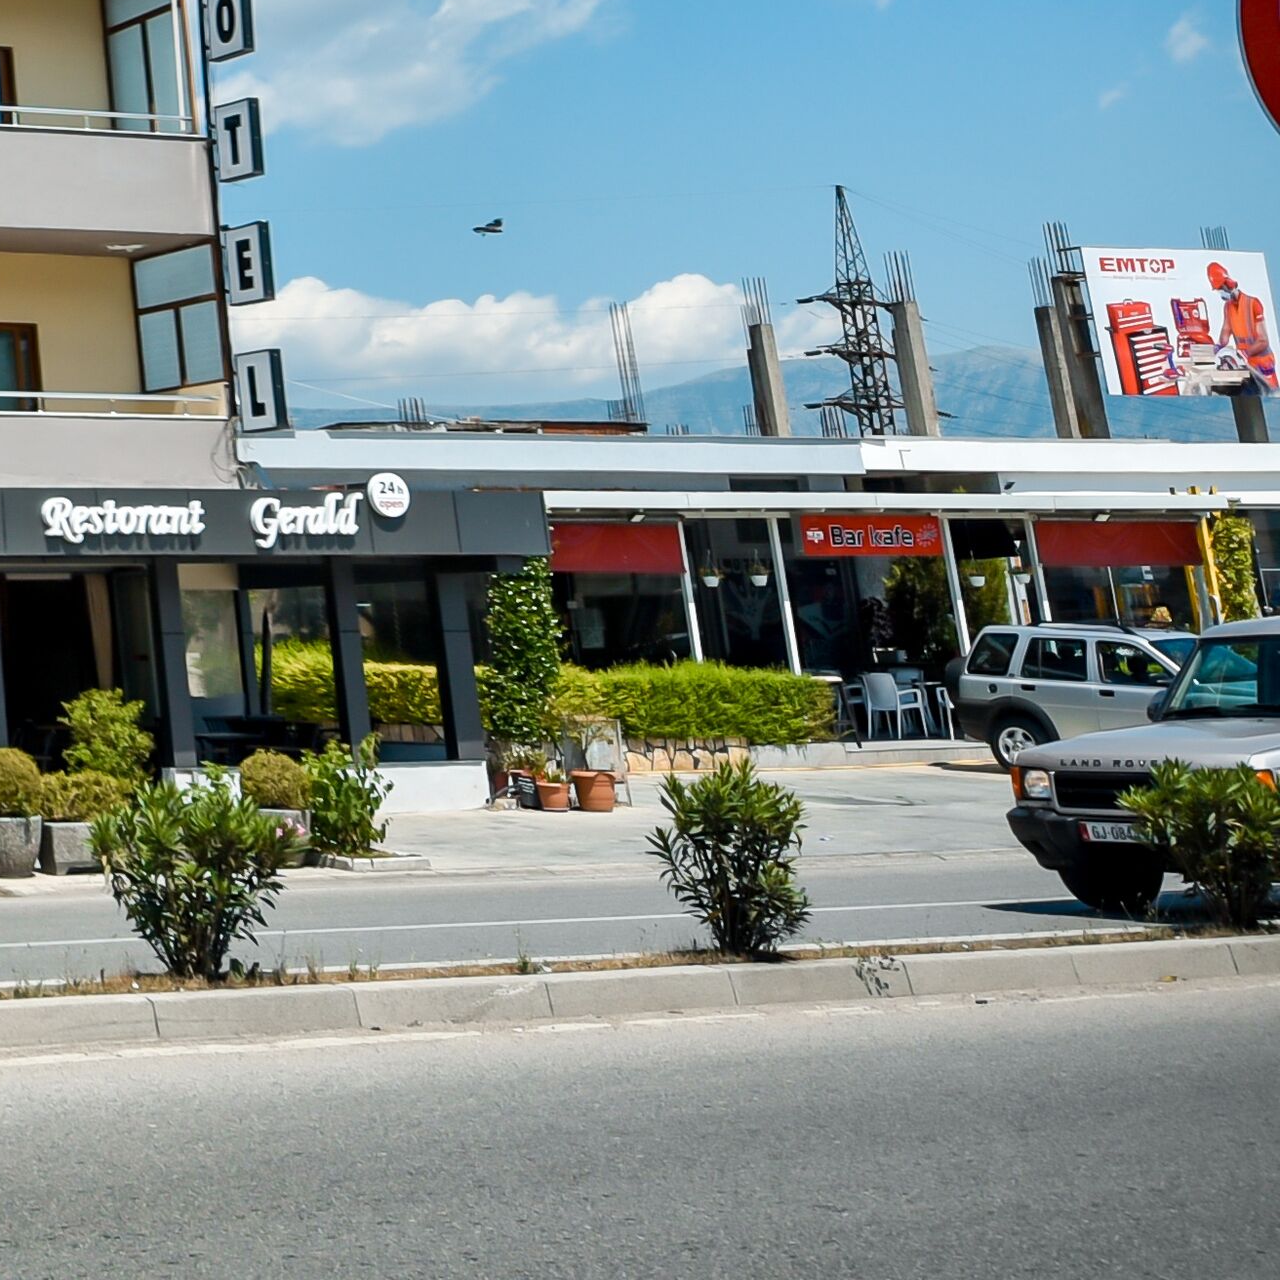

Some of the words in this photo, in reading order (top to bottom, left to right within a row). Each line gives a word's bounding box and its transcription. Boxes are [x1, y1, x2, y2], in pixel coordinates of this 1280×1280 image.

[1098, 257, 1176, 274] EMTOP
[41, 496, 207, 544] Restorant
[251, 492, 364, 549] Gerald
[829, 524, 865, 548] Bar
[868, 524, 914, 548] kafe
[1060, 759, 1102, 768] LAND
